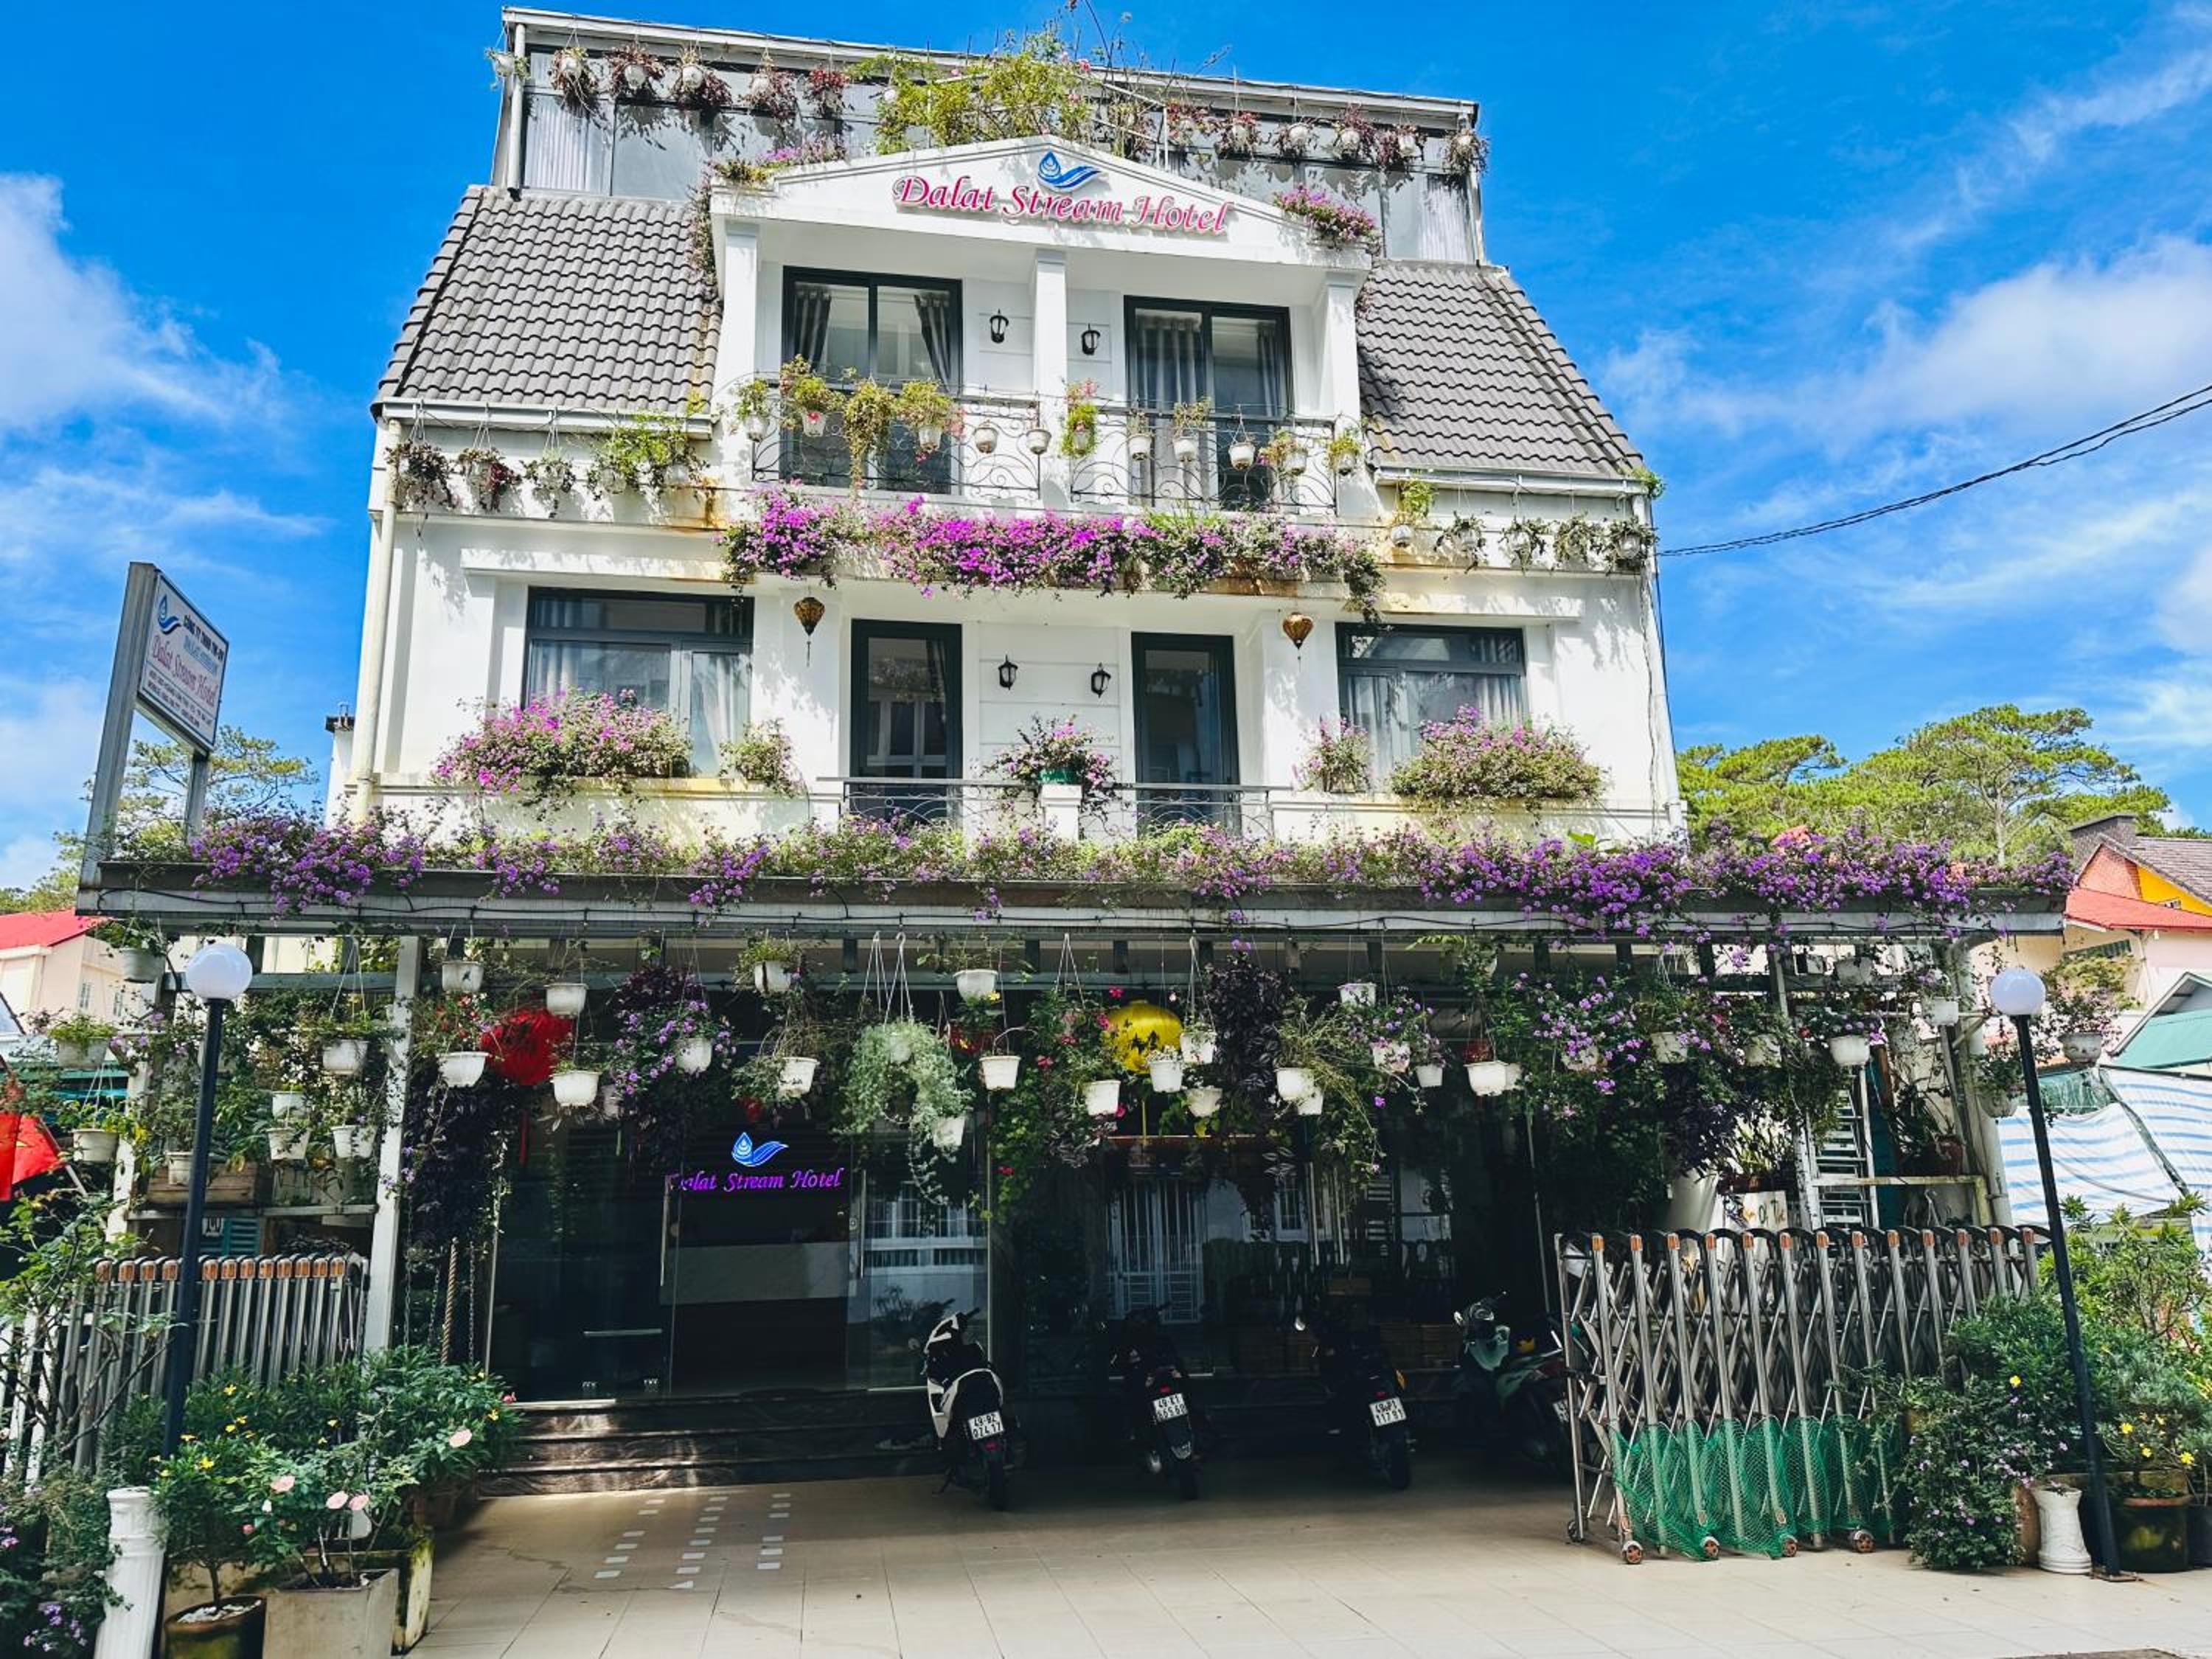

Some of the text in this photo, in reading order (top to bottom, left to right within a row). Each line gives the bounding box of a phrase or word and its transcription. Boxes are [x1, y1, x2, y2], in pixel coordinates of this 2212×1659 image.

[892, 175, 1234, 232] Dalat Stream Hotel
[723, 1172, 784, 1192] Stream
[790, 1168, 844, 1188] Hotel
